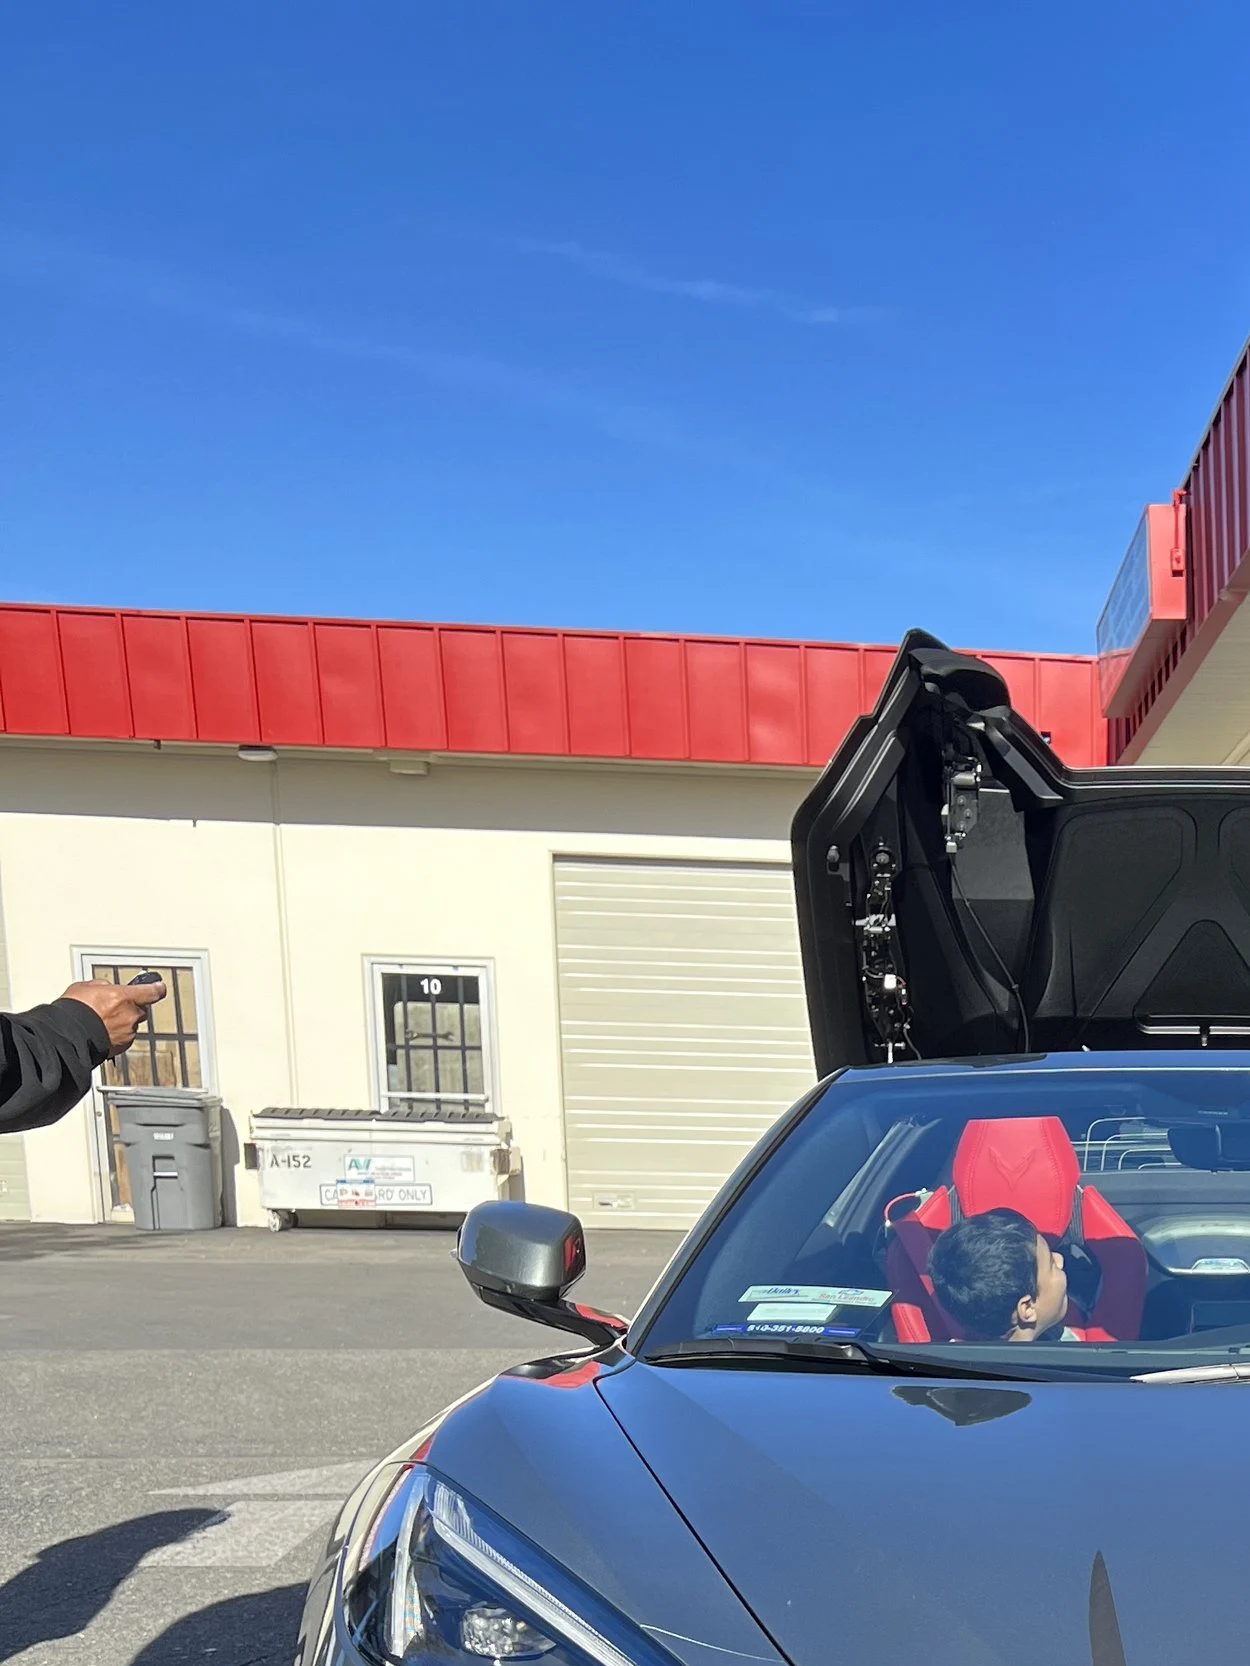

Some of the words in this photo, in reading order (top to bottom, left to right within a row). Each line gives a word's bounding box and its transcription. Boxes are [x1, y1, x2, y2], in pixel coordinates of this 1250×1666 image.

[420, 978, 442, 995] 10
[270, 1154, 312, 1168] A-152
[398, 1188, 427, 1201] ONLY
